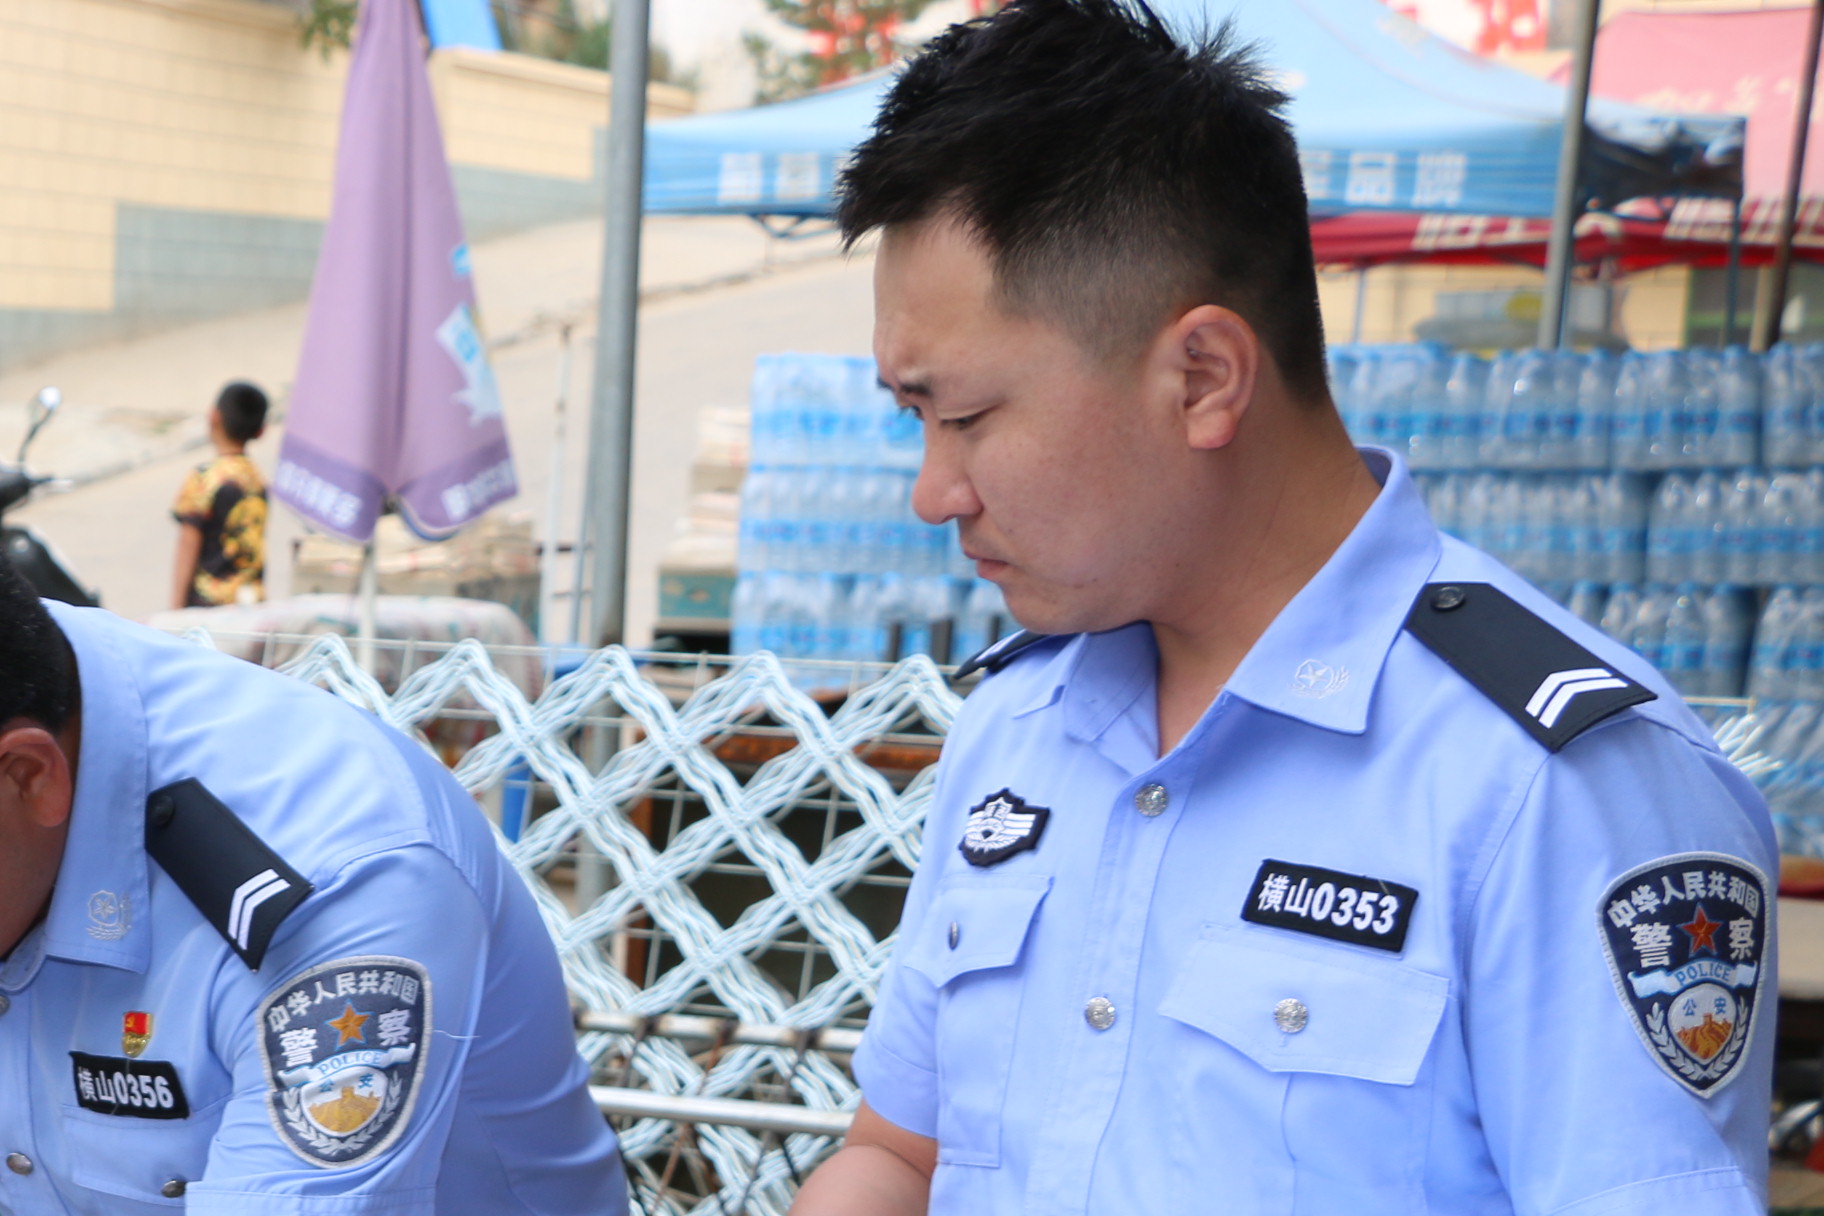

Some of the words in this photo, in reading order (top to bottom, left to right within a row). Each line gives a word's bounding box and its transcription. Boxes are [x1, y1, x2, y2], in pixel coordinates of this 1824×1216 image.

[1257, 871, 1399, 935] 横山0353
[1607, 870, 1760, 928] 中华人民共和国
[1675, 962, 1734, 986] POLICE
[267, 969, 420, 1033] 中华人民共和国
[77, 1066, 174, 1108] 横山0356
[318, 1053, 381, 1075] POLICE
